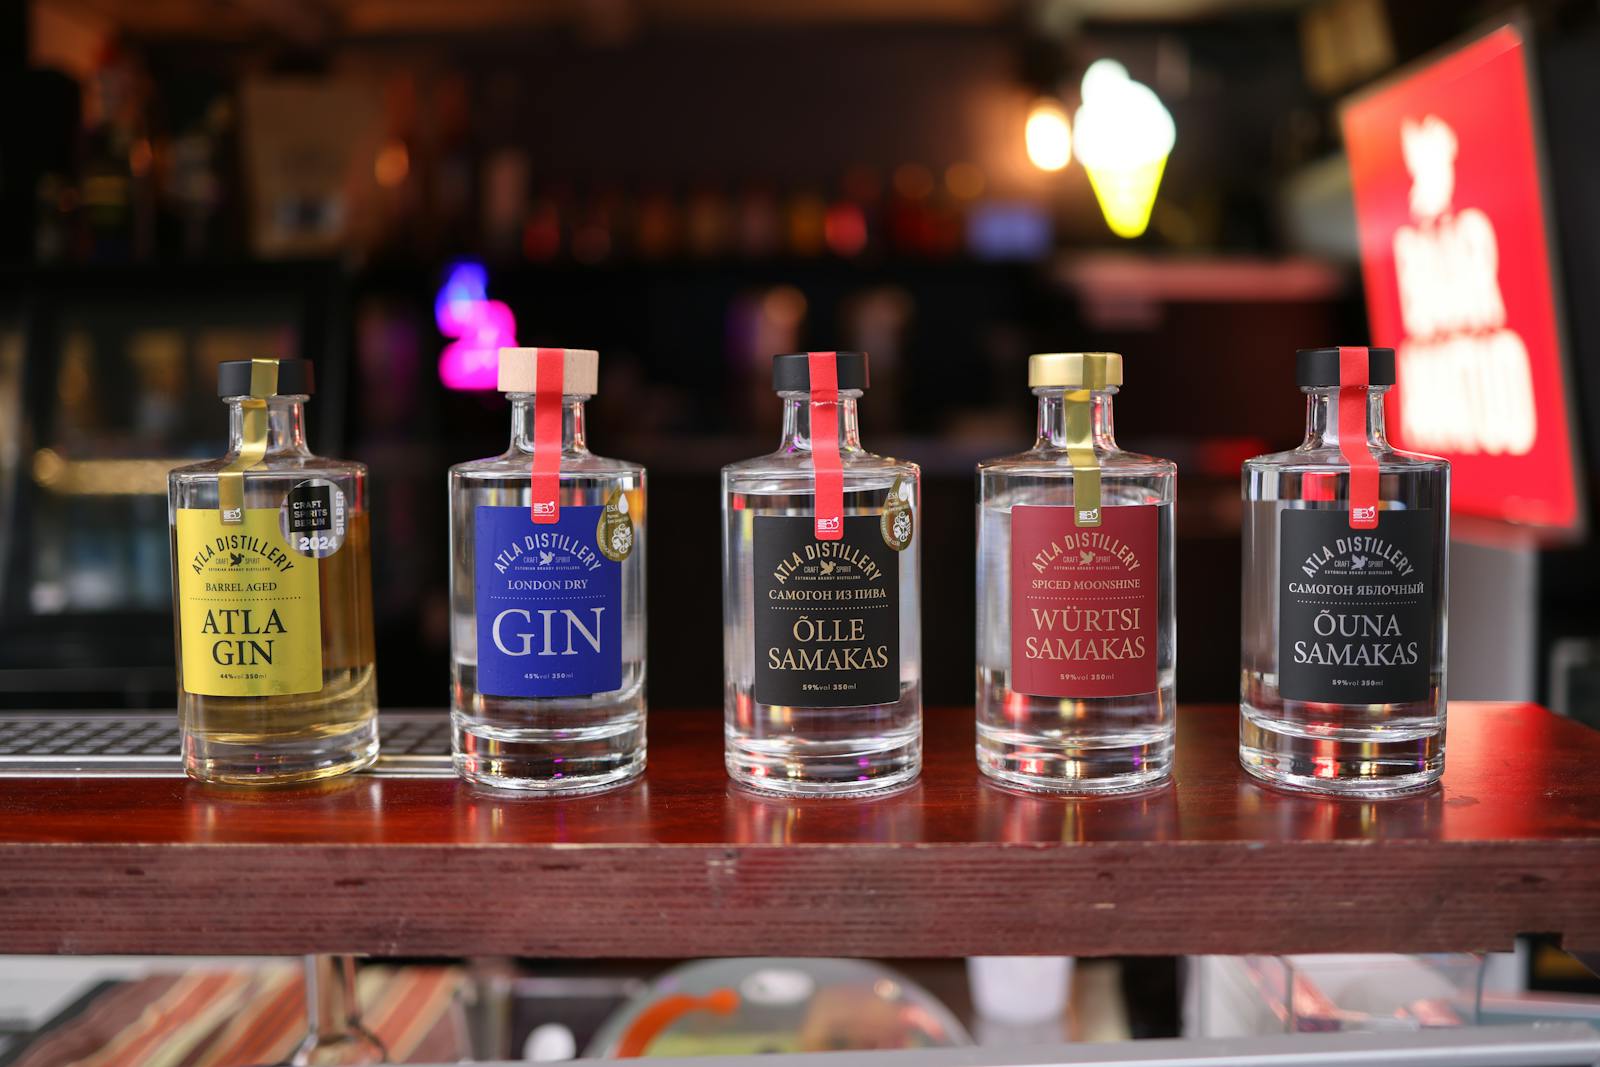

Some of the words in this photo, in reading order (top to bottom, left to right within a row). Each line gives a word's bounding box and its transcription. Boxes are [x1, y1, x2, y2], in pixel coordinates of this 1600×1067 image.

[293, 500, 322, 510] CRAFT
[294, 509, 328, 519] SPRITS
[336, 491, 345, 536] SILBER
[294, 518, 326, 527] BERLIN
[299, 536, 338, 550] 2024
[1032, 542, 1063, 574] ATLA
[1064, 532, 1141, 572] DISTILLERY
[192, 545, 216, 575] ATLA
[216, 535, 294, 573] DISTILLERY
[494, 542, 524, 575] ATLA
[525, 532, 602, 572] DISTILLERY
[523, 556, 538, 564] CRAFT
[773, 551, 804, 585] ATLA
[805, 541, 883, 582] DISTILLERY
[1301, 545, 1335, 578] ATLA
[1335, 536, 1414, 577] DISTILLERY
[803, 566, 819, 574] CRAFT
[836, 565, 852, 574] SPIRIT
[1334, 560, 1350, 568] CRAFT
[1367, 560, 1384, 568] SPIRIT
[205, 583, 243, 592] BARREL
[246, 582, 277, 591] AGED
[508, 579, 561, 590] LONDON
[564, 579, 589, 590] DRY
[768, 589, 832, 600] САМОГОН
[835, 590, 852, 600] ИЗ
[854, 588, 887, 600] ПИВА
[1032, 579, 1071, 590] SPICED
[1073, 578, 1141, 590] MOONSHINE
[1288, 582, 1353, 596] САМОГОН
[1356, 581, 1425, 596] ЯБЛОЧНЫЙ
[201, 608, 288, 635] ATLA
[793, 615, 865, 642] ÕLLE
[1031, 605, 1141, 632] WÜRTSI
[1313, 609, 1402, 638] ÕUNA
[492, 607, 606, 656] GIN
[212, 640, 275, 666] GIN
[768, 645, 889, 671] SAMAKAS
[1025, 635, 1146, 661] SAMAKAS
[1294, 640, 1418, 667] SAMAKAS
[802, 683, 831, 691] 59%vol
[1059, 673, 1089, 681] 59%vol
[1361, 679, 1384, 687] 350ml
